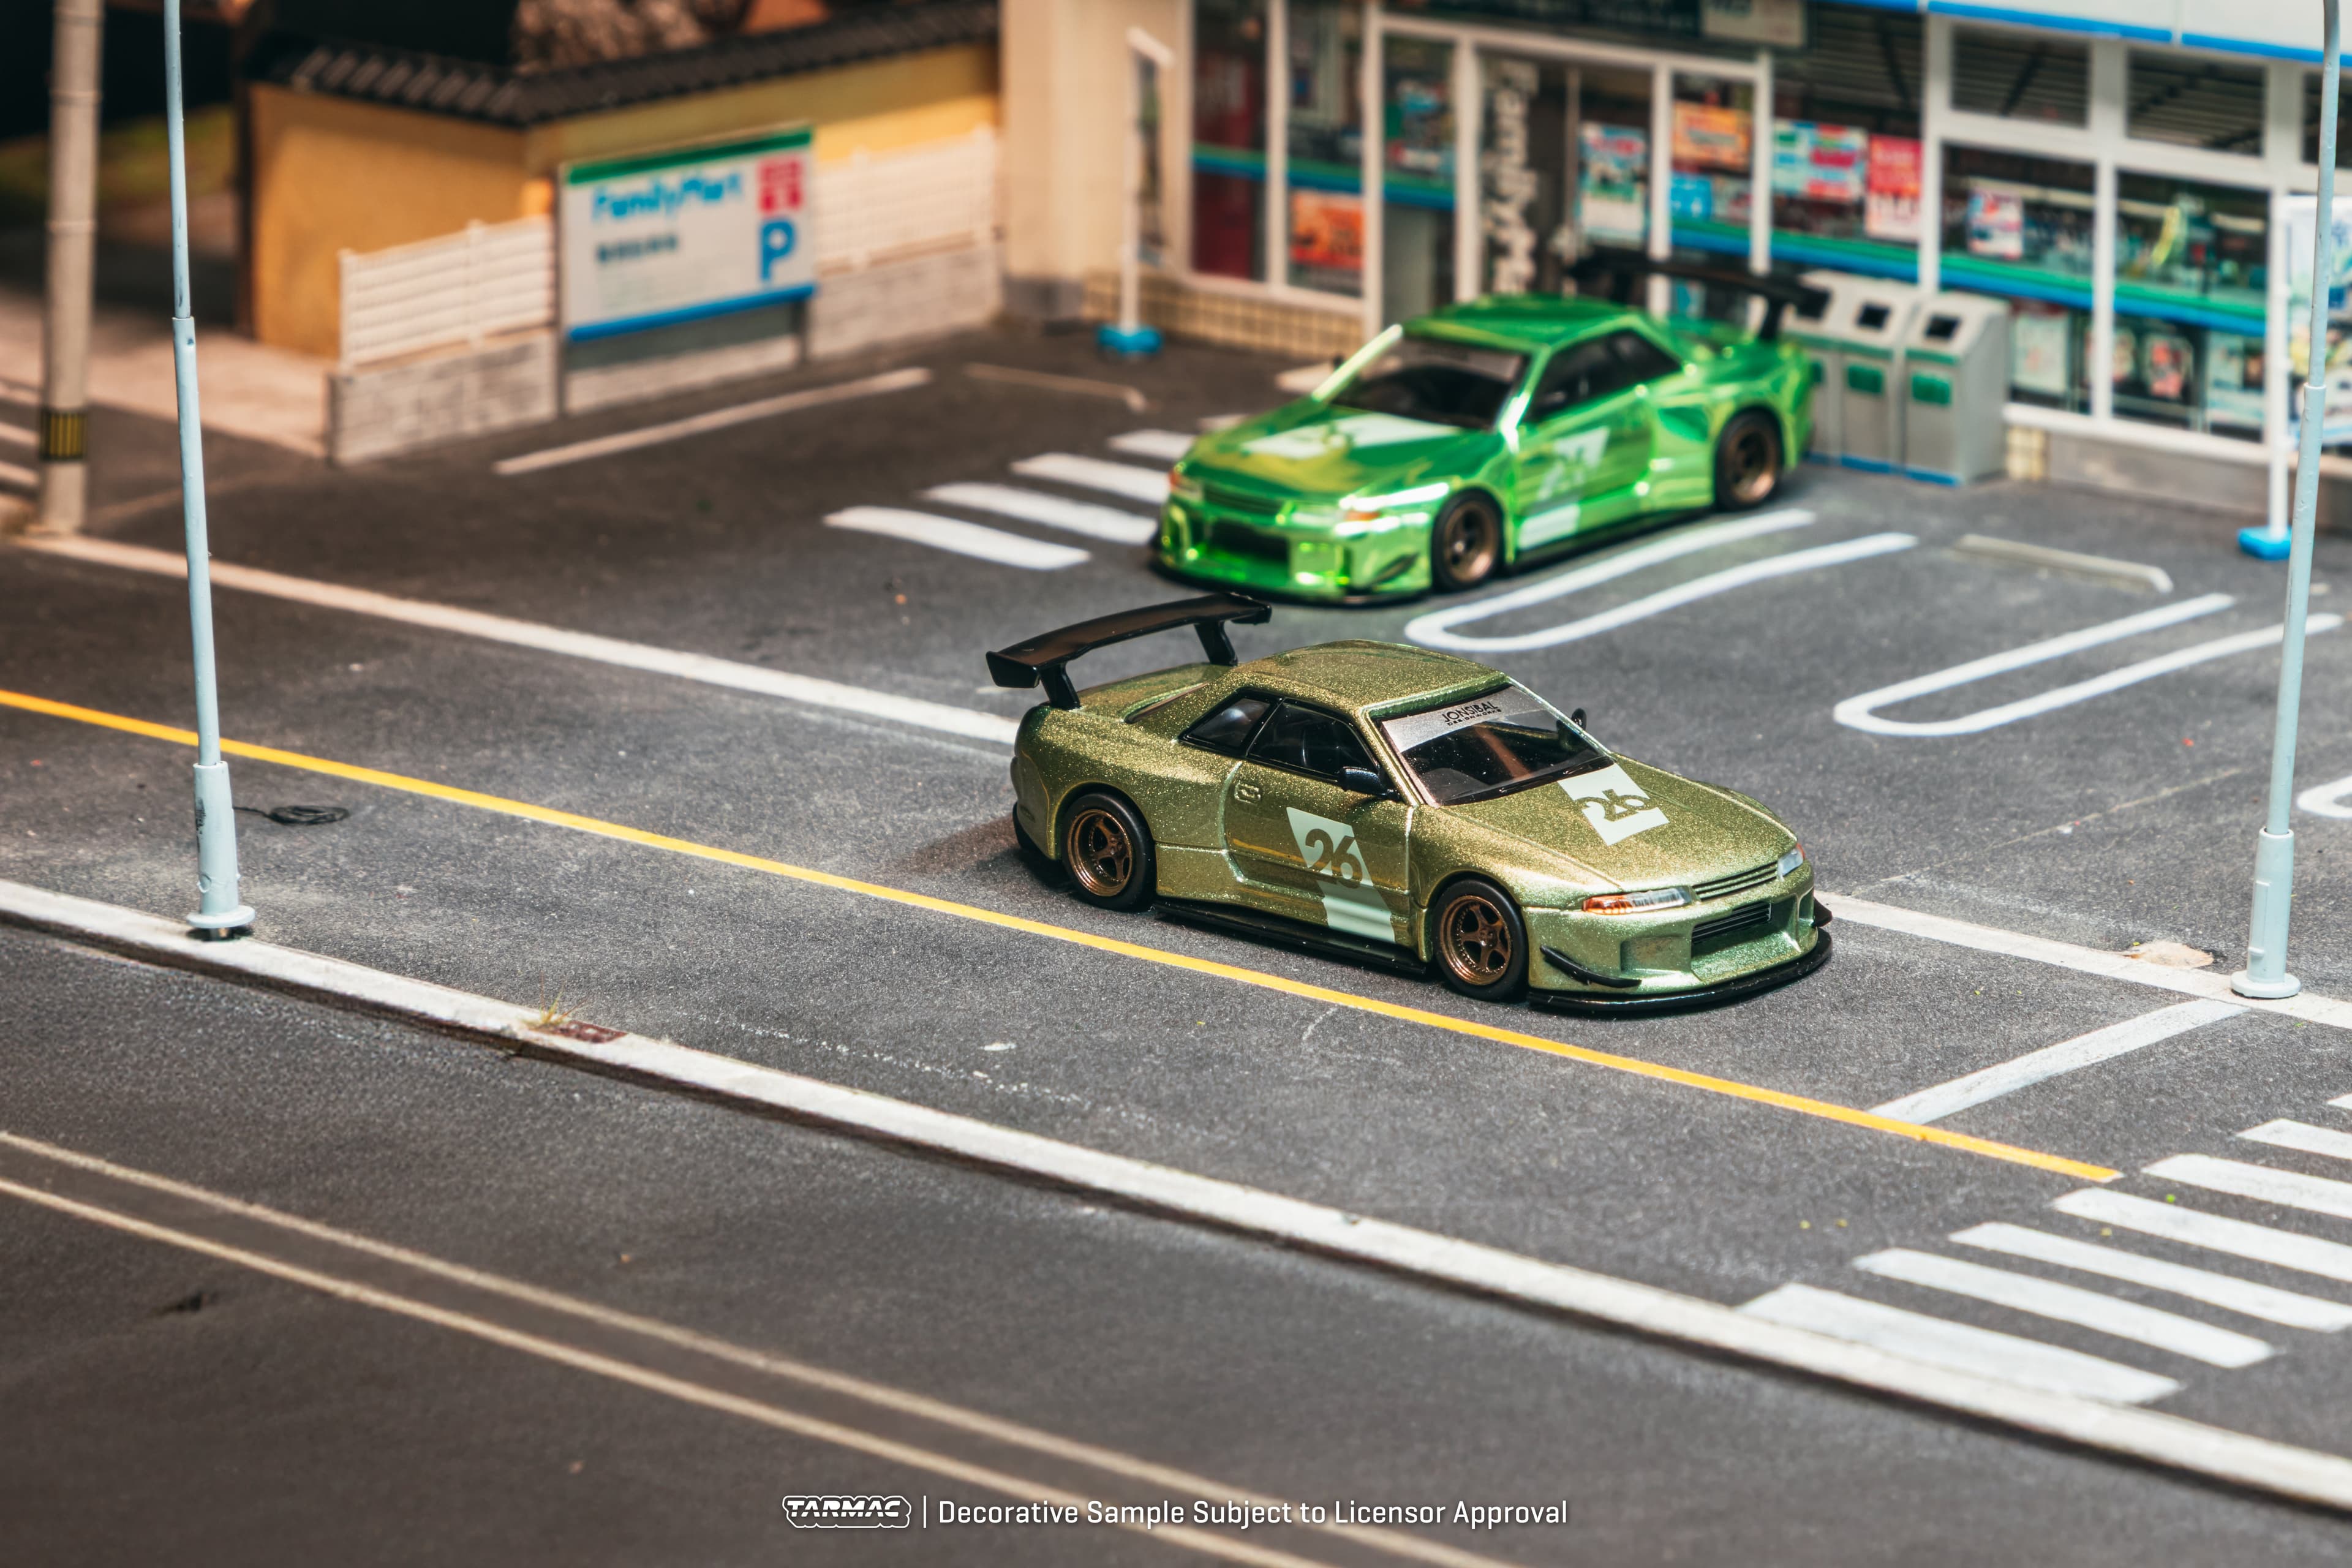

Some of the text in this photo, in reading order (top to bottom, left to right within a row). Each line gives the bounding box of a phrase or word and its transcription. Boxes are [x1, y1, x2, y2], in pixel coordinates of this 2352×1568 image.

[760, 219, 796, 282] P
[1442, 701, 1498, 722] JONSIBAL
[1574, 788, 1657, 822] 26
[1305, 828, 1363, 888] 26
